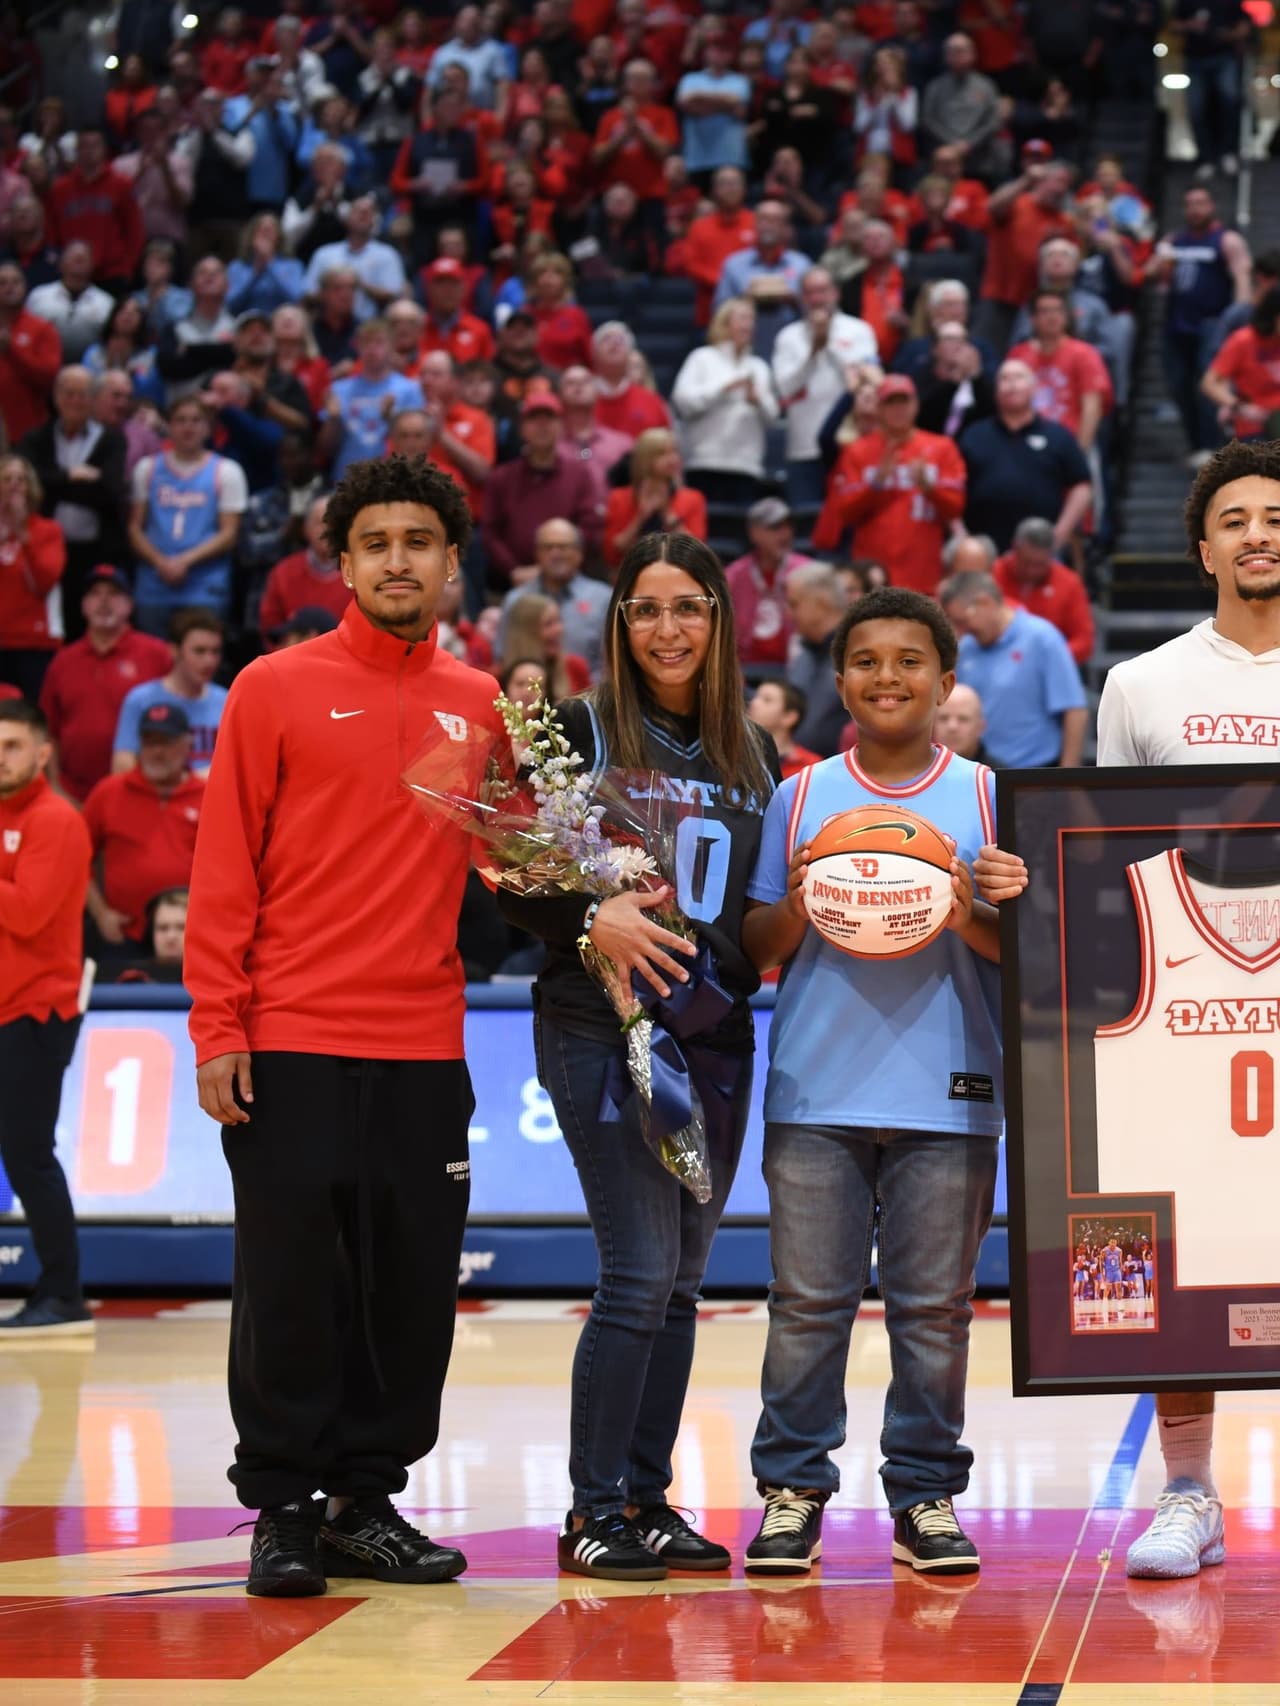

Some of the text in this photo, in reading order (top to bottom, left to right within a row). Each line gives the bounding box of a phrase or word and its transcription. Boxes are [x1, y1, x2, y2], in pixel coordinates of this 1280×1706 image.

[675, 816, 731, 924] 0
[857, 885, 933, 906] BENNETT
[812, 907, 862, 928] COLLEGIATE POINT
[889, 916, 928, 929] AT DAYTON
[913, 907, 933, 918] POINT
[1230, 1050, 1275, 1137] 0
[104, 1056, 142, 1167] 1
[458, 1251, 496, 1286] ger
